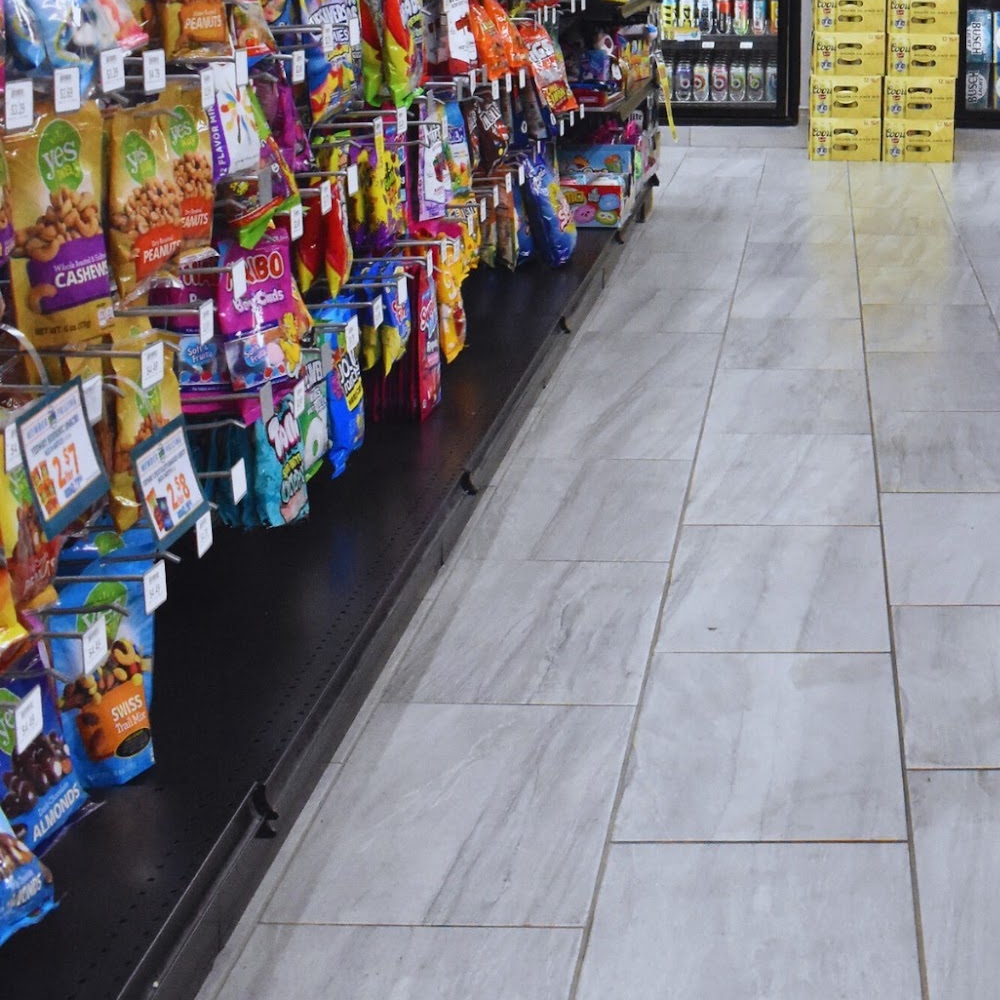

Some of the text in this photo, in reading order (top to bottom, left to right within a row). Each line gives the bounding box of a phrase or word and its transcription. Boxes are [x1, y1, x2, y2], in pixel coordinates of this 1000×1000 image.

[184, 14, 222, 30] PEANUTS
[971, 22, 981, 55] BUSCH
[967, 72, 979, 103] BUSCH
[170, 121, 192, 146] yes
[211, 123, 226, 167] FLAVOR
[42, 140, 78, 180] yes
[53, 261, 75, 272] Whole
[51, 456, 66, 489] 2
[166, 482, 178, 511] 2
[111, 694, 143, 722] SWISS
[115, 711, 147, 734] Trail Mix
[32, 783, 81, 842] ALMONDS
